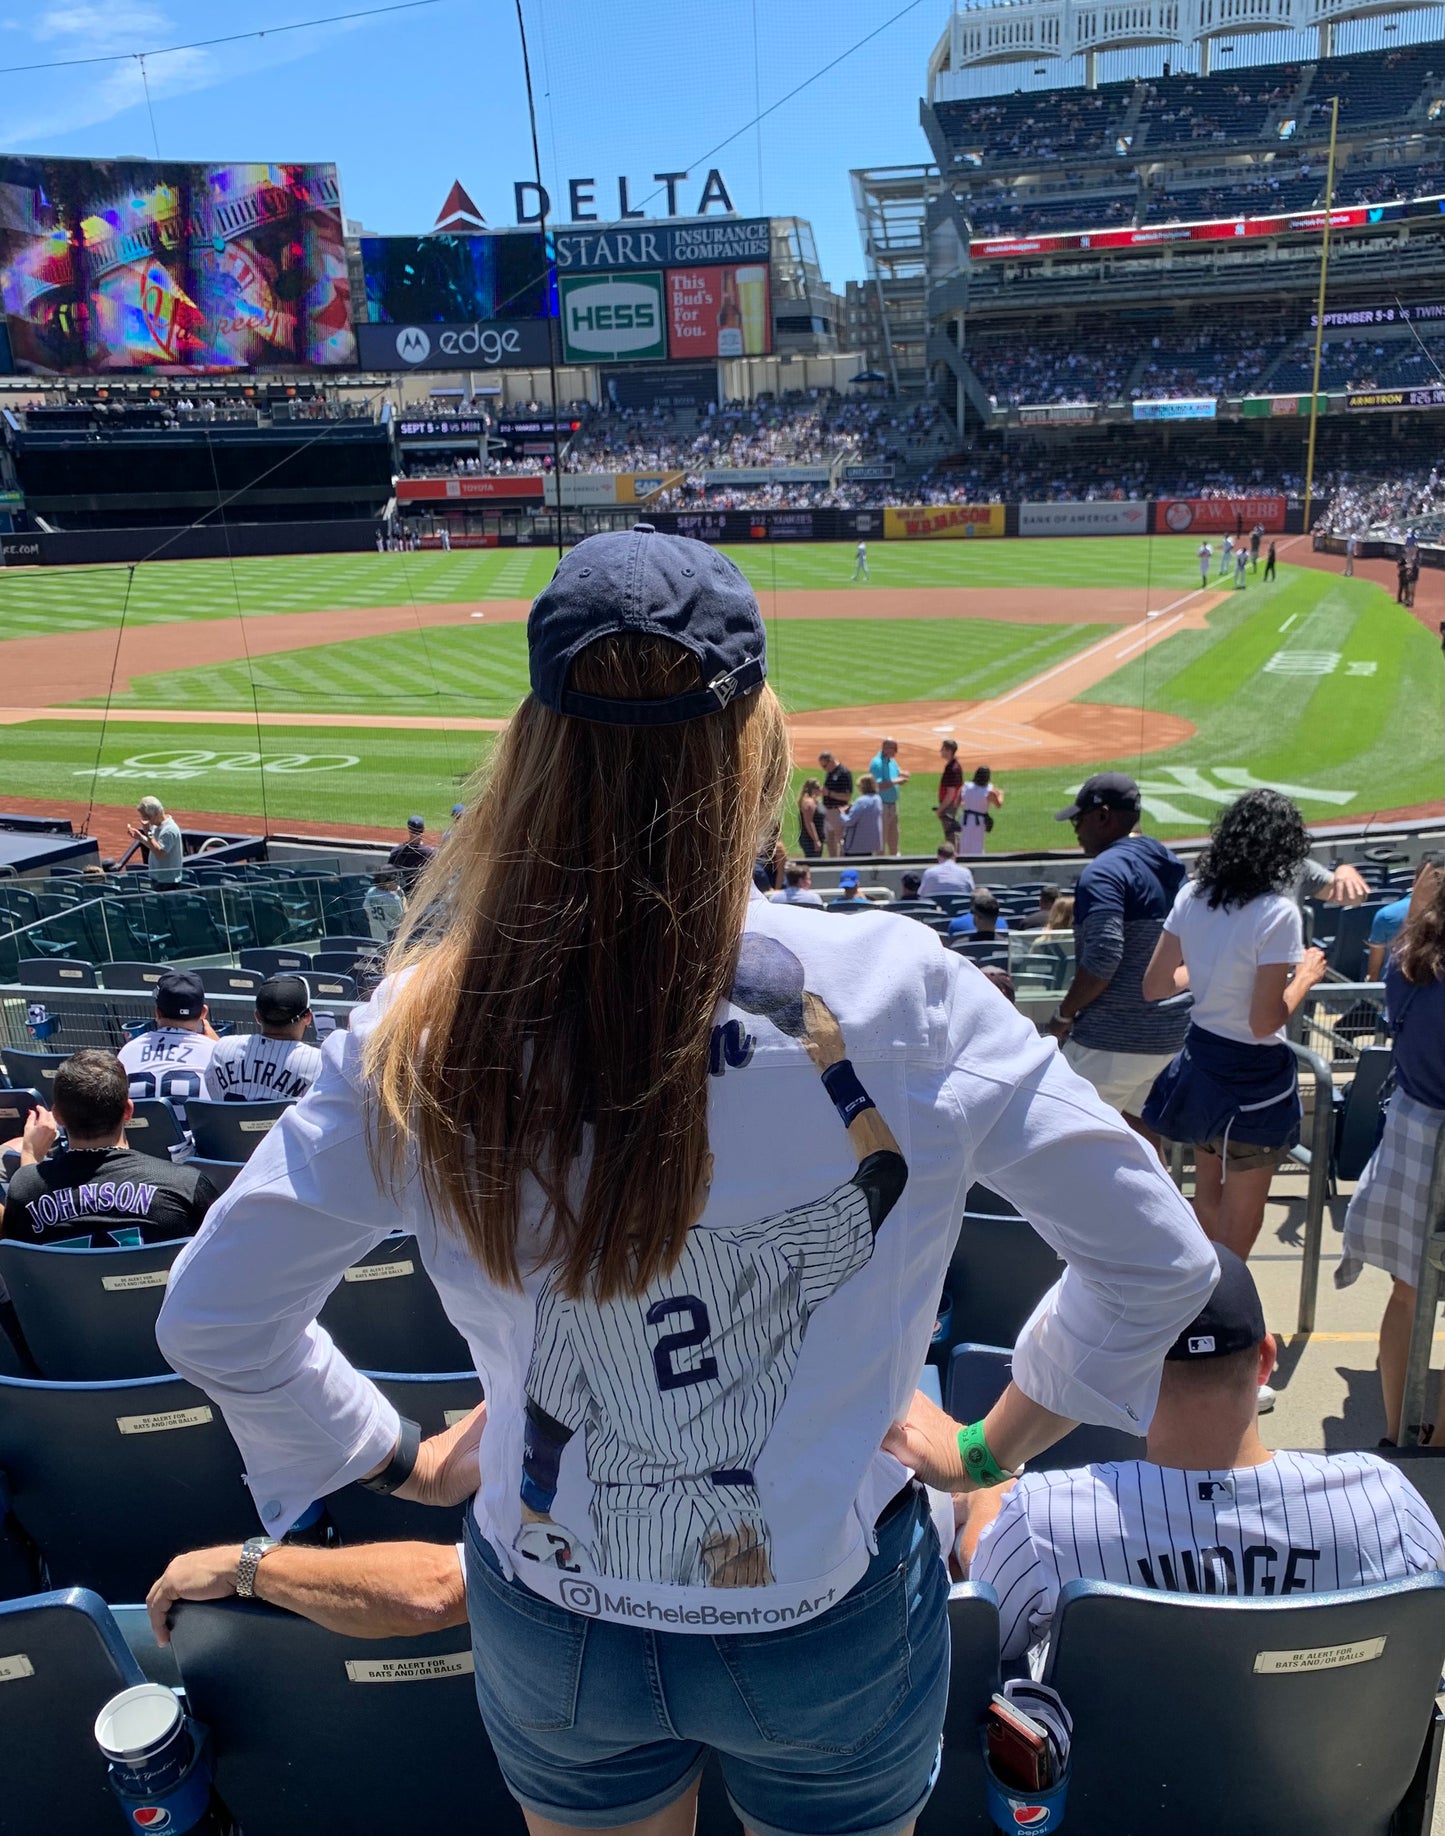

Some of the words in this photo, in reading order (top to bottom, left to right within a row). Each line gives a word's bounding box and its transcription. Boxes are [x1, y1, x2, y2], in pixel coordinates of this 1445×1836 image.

[514, 169, 734, 224] DELTA
[675, 223, 769, 246] INSURANCE
[556, 233, 663, 266] STARR
[674, 238, 769, 261] COMPANIES
[671, 273, 705, 290] This
[672, 290, 713, 306] Bud's
[572, 303, 654, 332] HESS
[673, 306, 698, 322] For
[1311, 310, 1373, 327] SPTEMBER
[674, 323, 706, 337] You.
[439, 323, 521, 363] edge
[400, 422, 426, 434] SEPT
[461, 421, 481, 433] MIN
[463, 484, 494, 493] TOYOTA
[1229, 501, 1279, 519] WEBB
[141, 1037, 195, 1063] BÁEZ
[215, 1058, 307, 1098] BELTRAN
[25, 1181, 158, 1233] JOHNSON
[646, 1294, 719, 1391] 2
[133, 1422, 151, 1430] BATS
[151, 1419, 178, 1428] AND/OR
[178, 1416, 199, 1424] BALLS
[604, 1587, 837, 1625] MicheleBentonArt
[1275, 1661, 1298, 1669] BATS
[1300, 1656, 1337, 1667] AND/OR
[1338, 1651, 1365, 1662] BALLS
[1307, 1651, 1334, 1660] ALERT
[1335, 1647, 1352, 1656] FOR
[368, 1670, 392, 1678] BATS
[394, 1668, 432, 1677] AND/OR
[434, 1663, 462, 1674] BALLS
[397, 1661, 425, 1670] ALERT
[427, 1659, 446, 1667] FOR
[1017, 1826, 1048, 1836] pepsi
